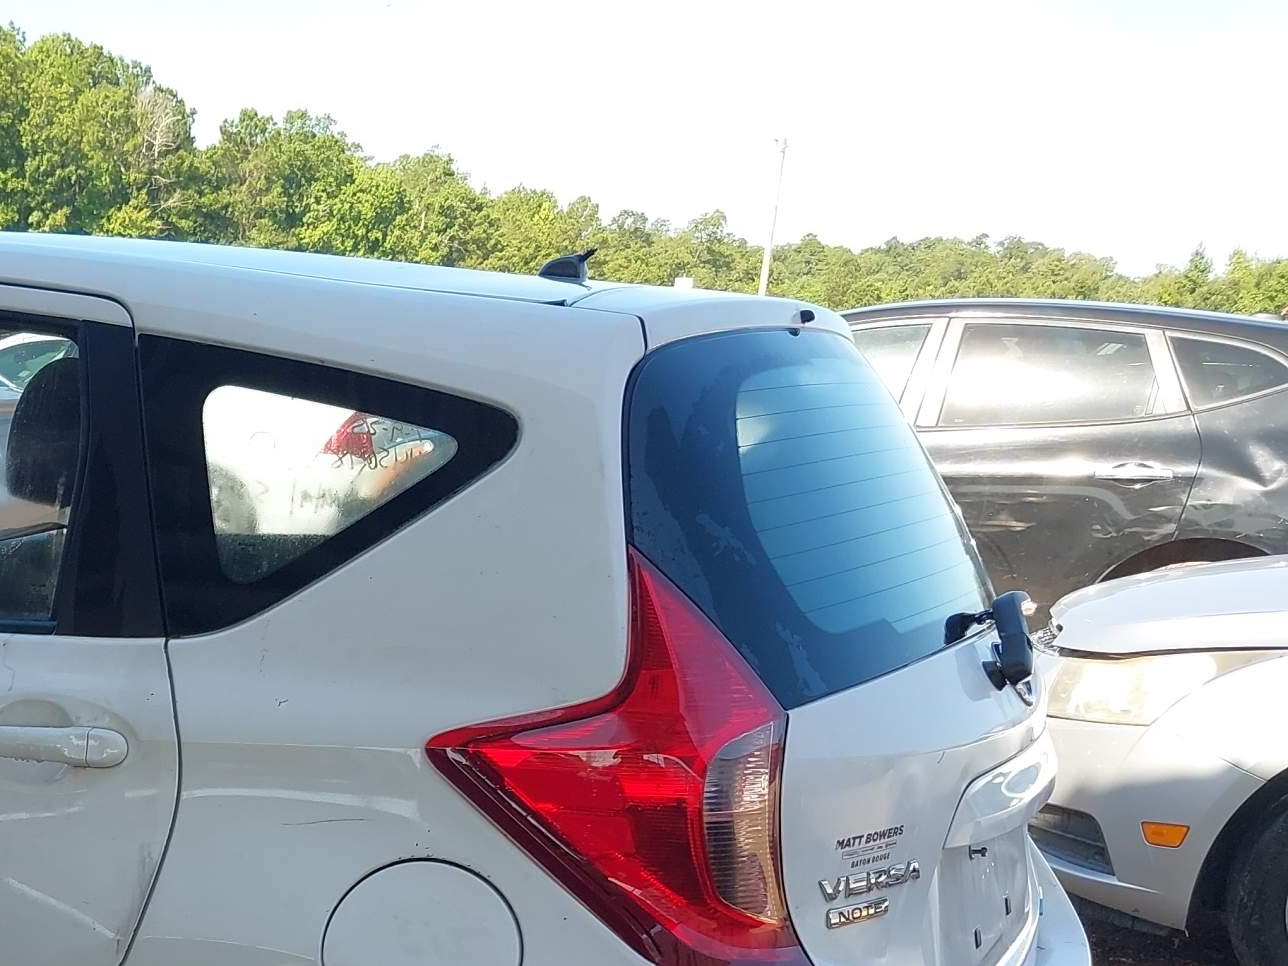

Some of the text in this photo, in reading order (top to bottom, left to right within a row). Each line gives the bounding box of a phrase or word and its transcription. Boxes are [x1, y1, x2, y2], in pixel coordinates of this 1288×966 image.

[834, 834, 865, 850] MATT
[865, 825, 904, 844] BOWERS
[818, 859, 920, 902] VERSA
[834, 899, 889, 926] NOTE
